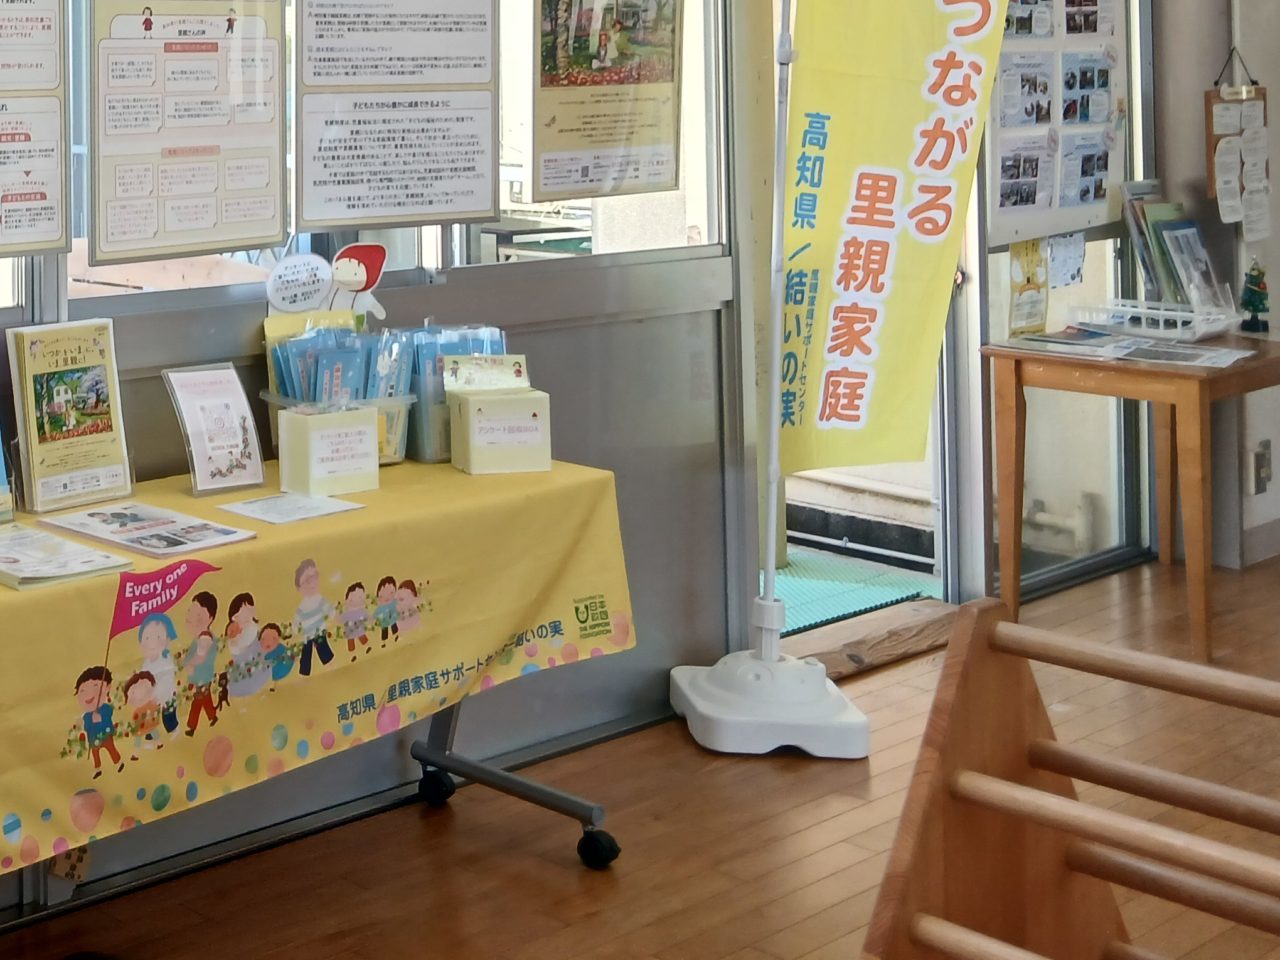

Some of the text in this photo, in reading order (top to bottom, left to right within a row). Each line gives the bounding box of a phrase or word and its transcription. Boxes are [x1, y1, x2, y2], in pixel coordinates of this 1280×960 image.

[818, 171, 898, 422] 里親家庭
[124, 561, 188, 598] Every one
[130, 584, 179, 617] Family
